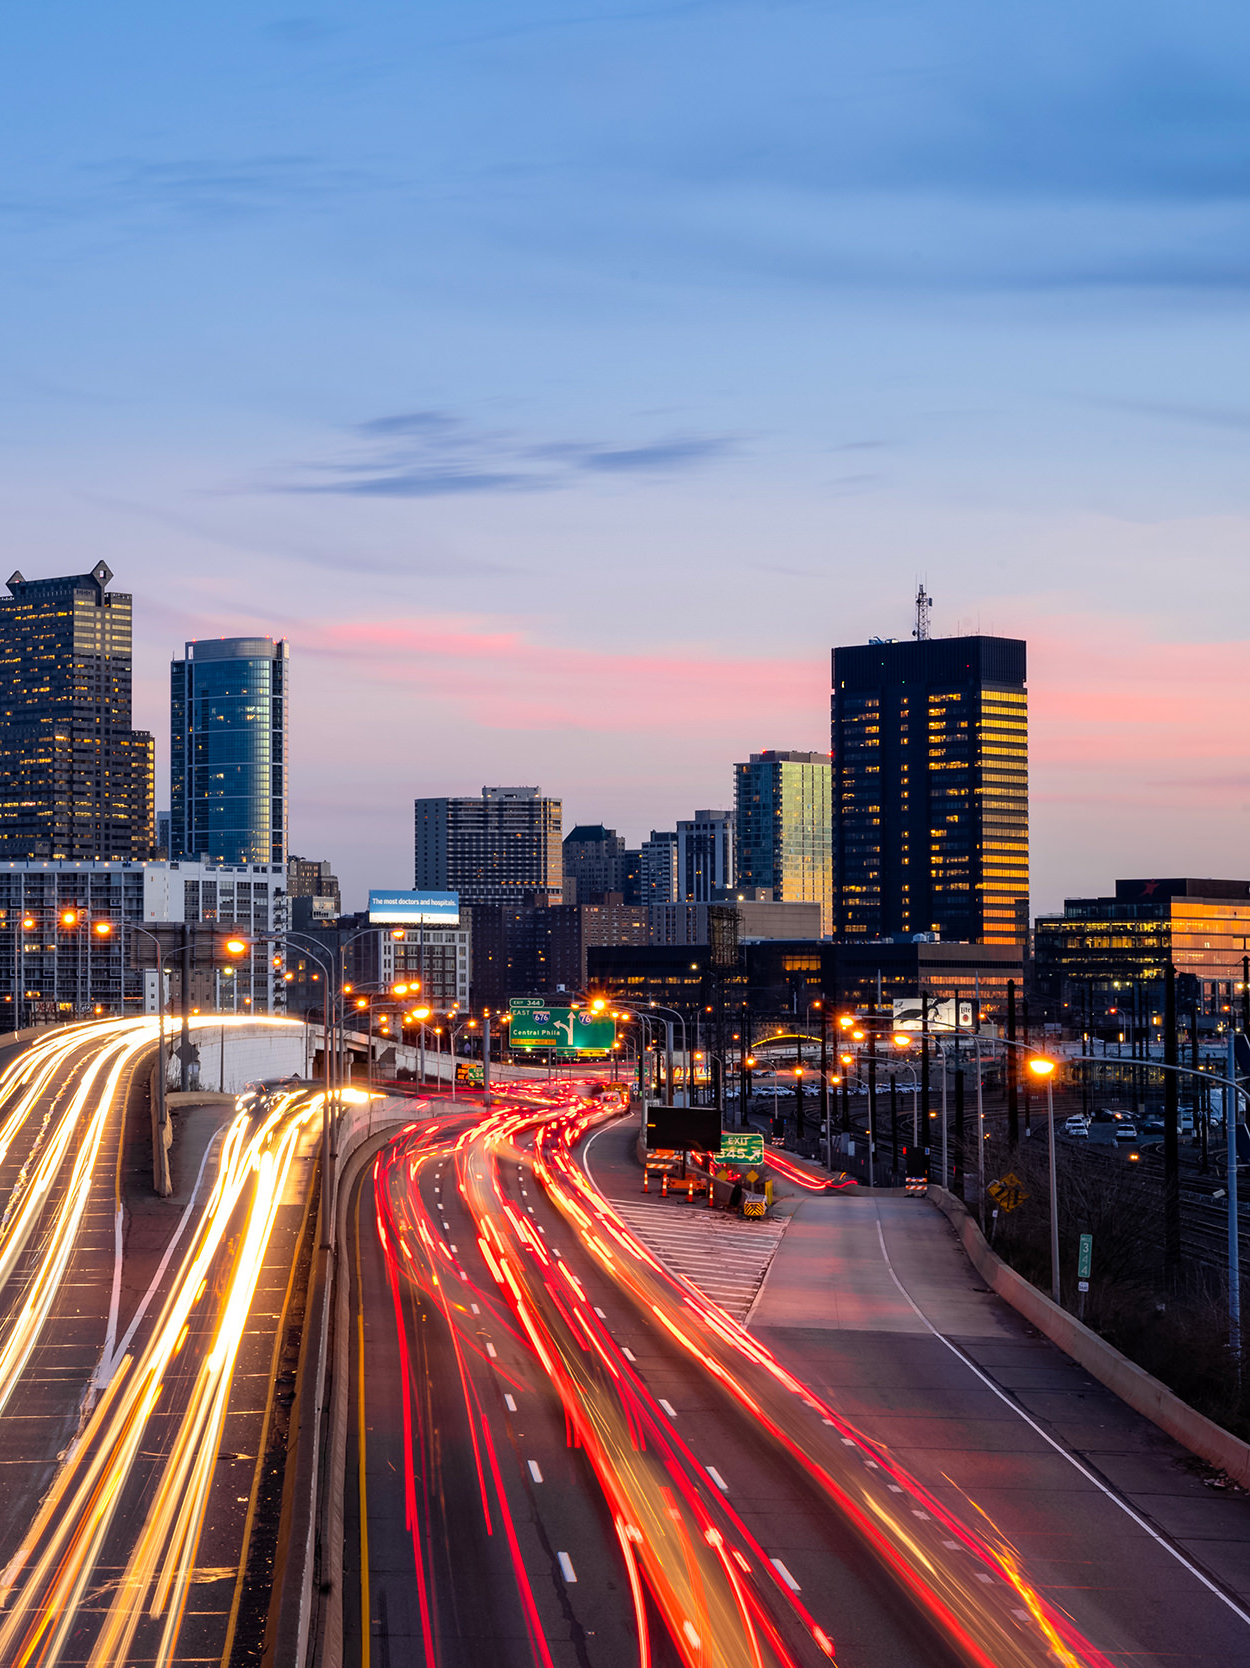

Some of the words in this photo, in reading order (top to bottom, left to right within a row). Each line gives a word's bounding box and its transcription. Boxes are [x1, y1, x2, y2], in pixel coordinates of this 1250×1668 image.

[372, 897, 383, 905] The
[431, 898, 456, 907] hospitals.
[581, 1014, 591, 1023] 76
[728, 1137, 748, 1145] EXIT
